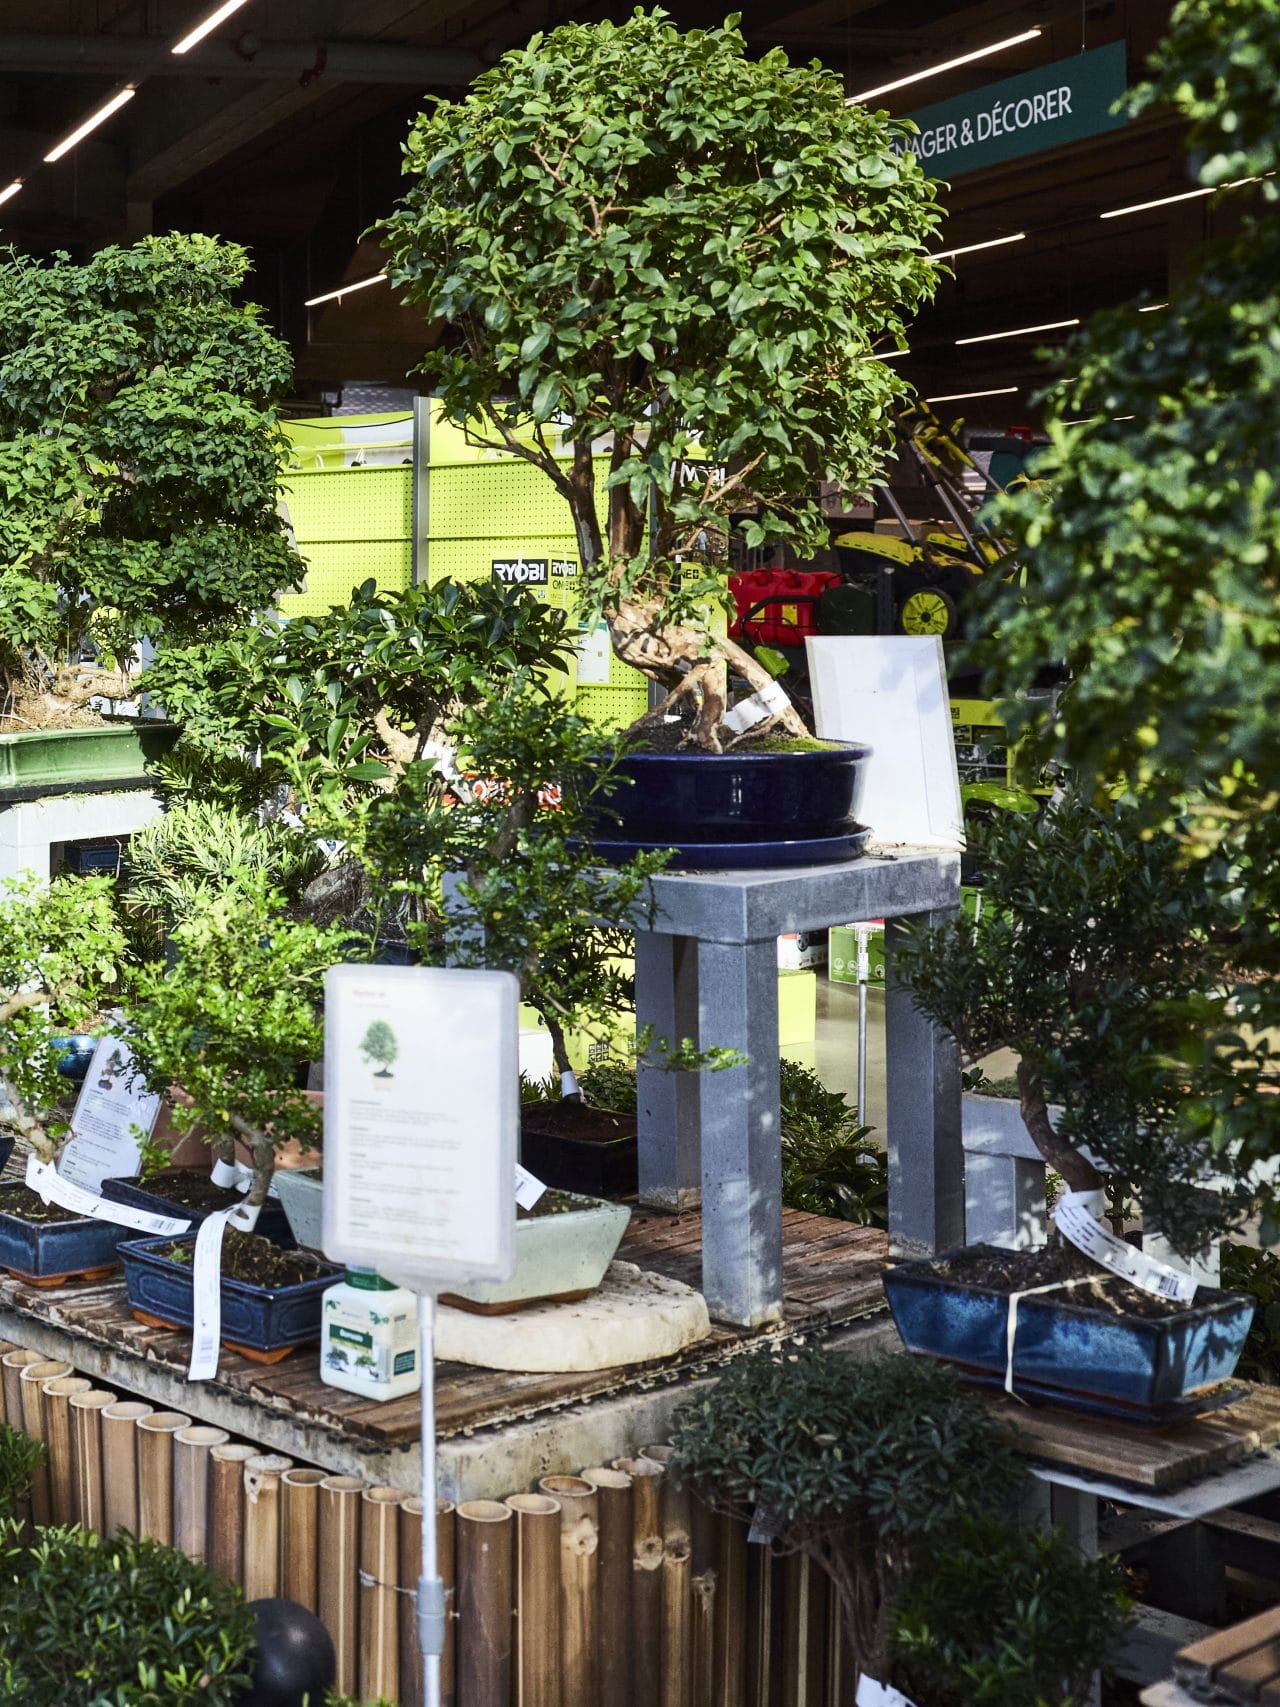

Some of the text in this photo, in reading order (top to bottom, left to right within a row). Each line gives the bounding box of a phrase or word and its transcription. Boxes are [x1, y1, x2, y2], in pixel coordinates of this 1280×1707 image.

[960, 118, 974, 146] &
[977, 85, 1073, 142] DÉCORER
[493, 563, 546, 581] RYOBI
